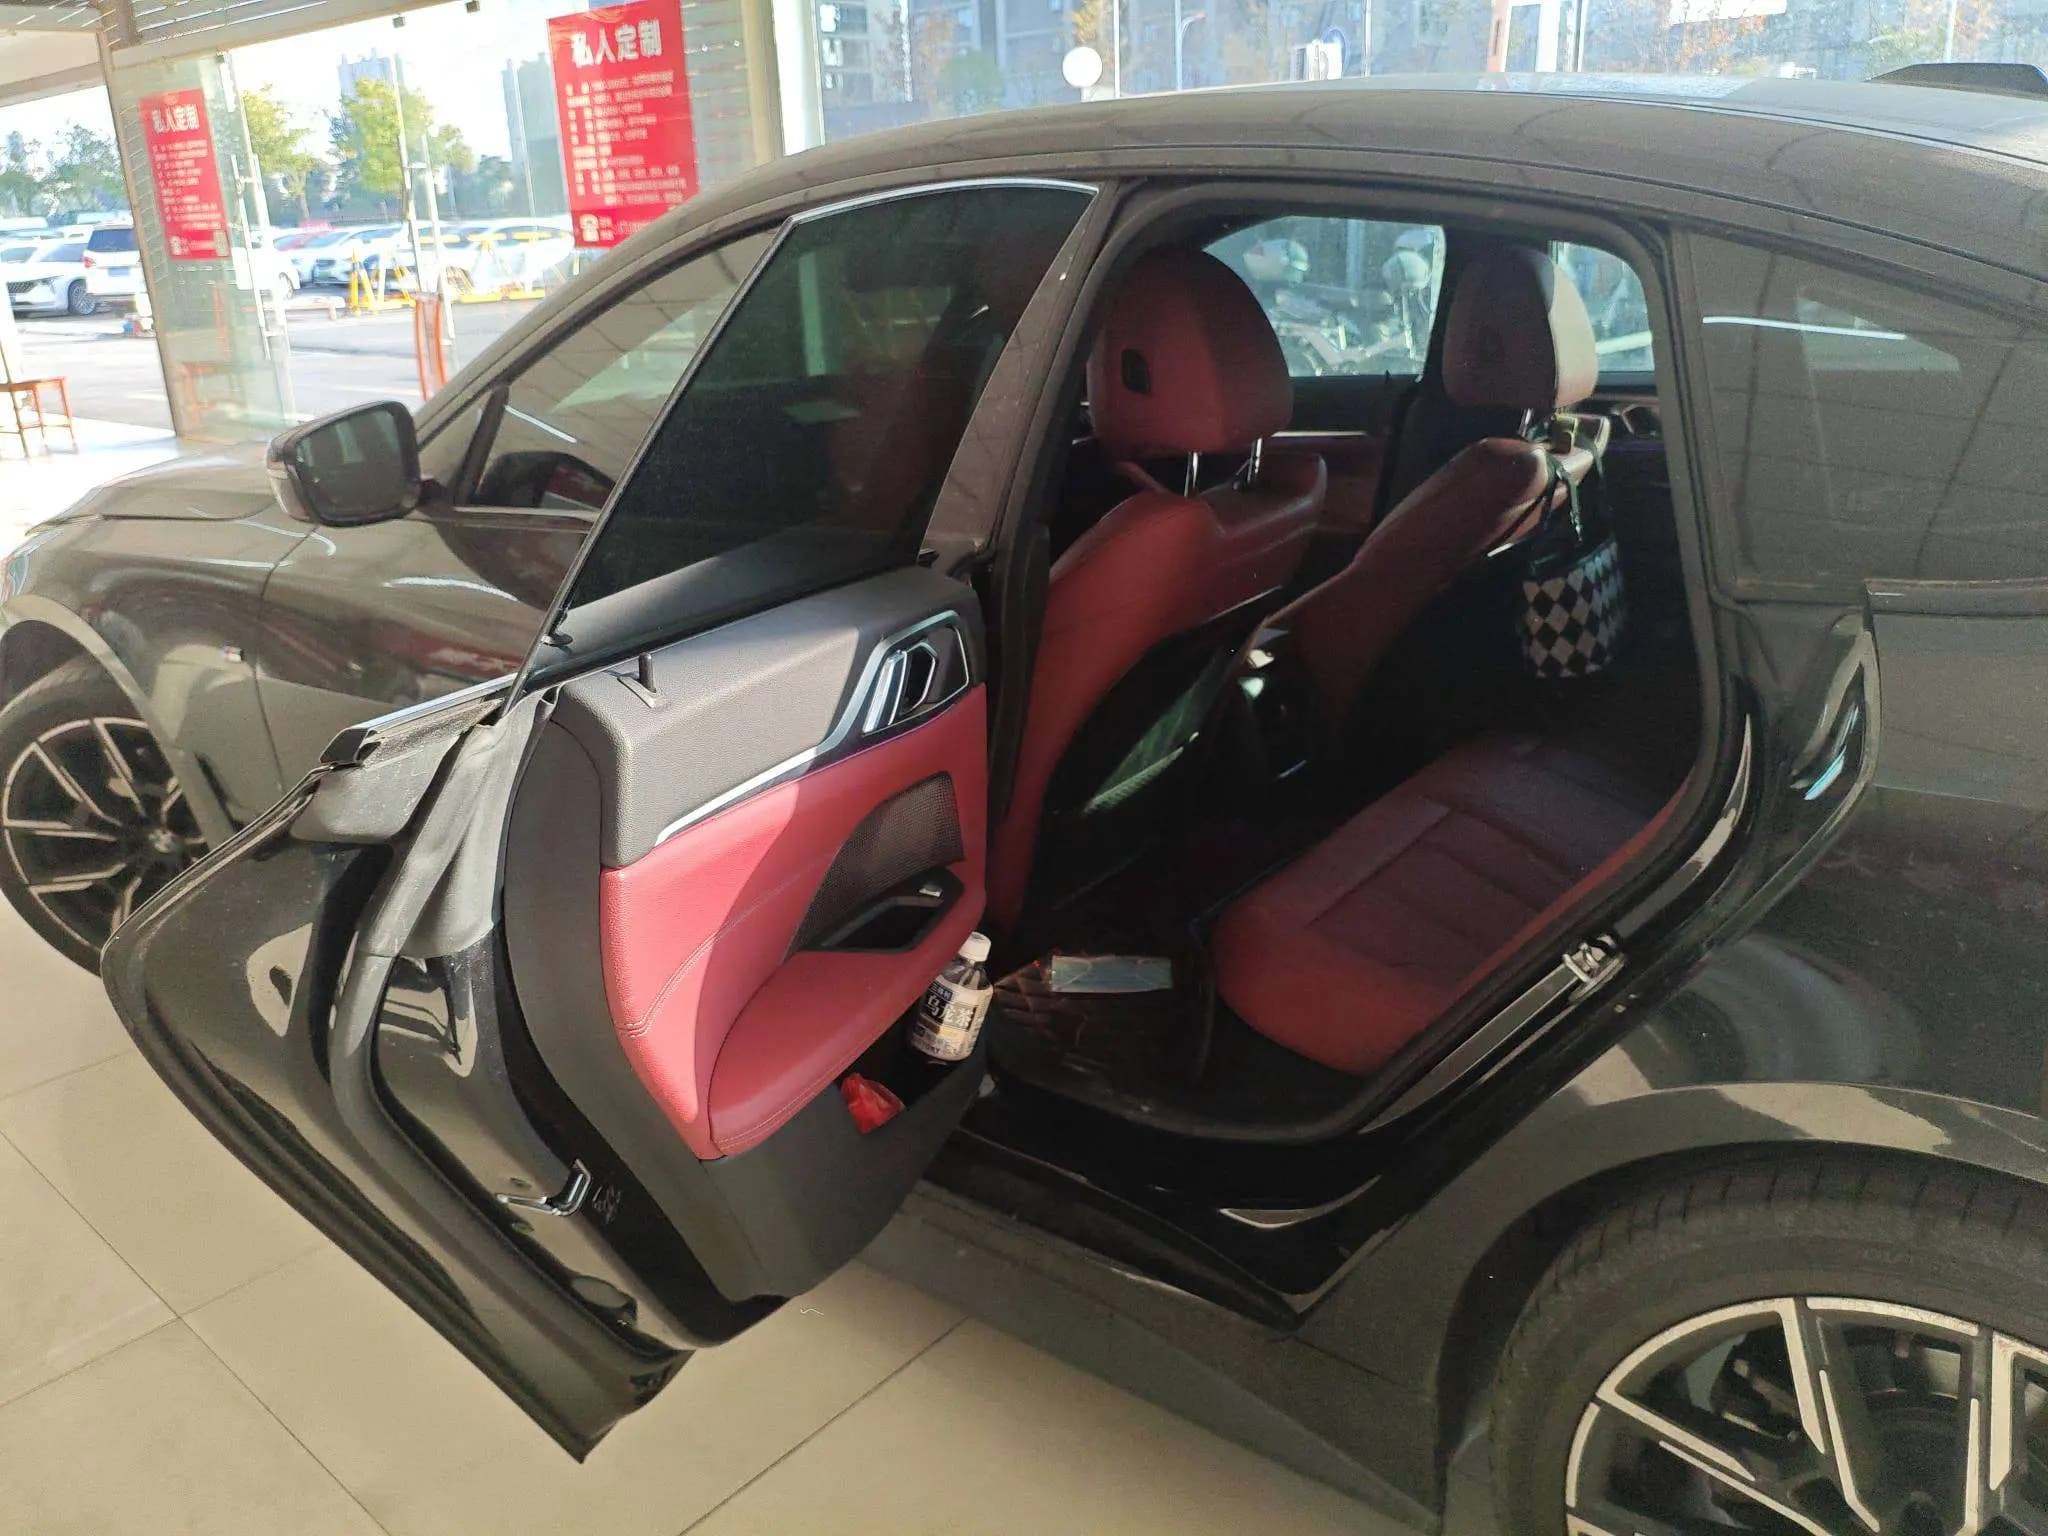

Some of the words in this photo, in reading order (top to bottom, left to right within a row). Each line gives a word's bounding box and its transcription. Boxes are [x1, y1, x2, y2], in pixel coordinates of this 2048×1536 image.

[571, 19, 662, 68] 私人定制
[928, 994, 973, 1029] 乌龙茶
